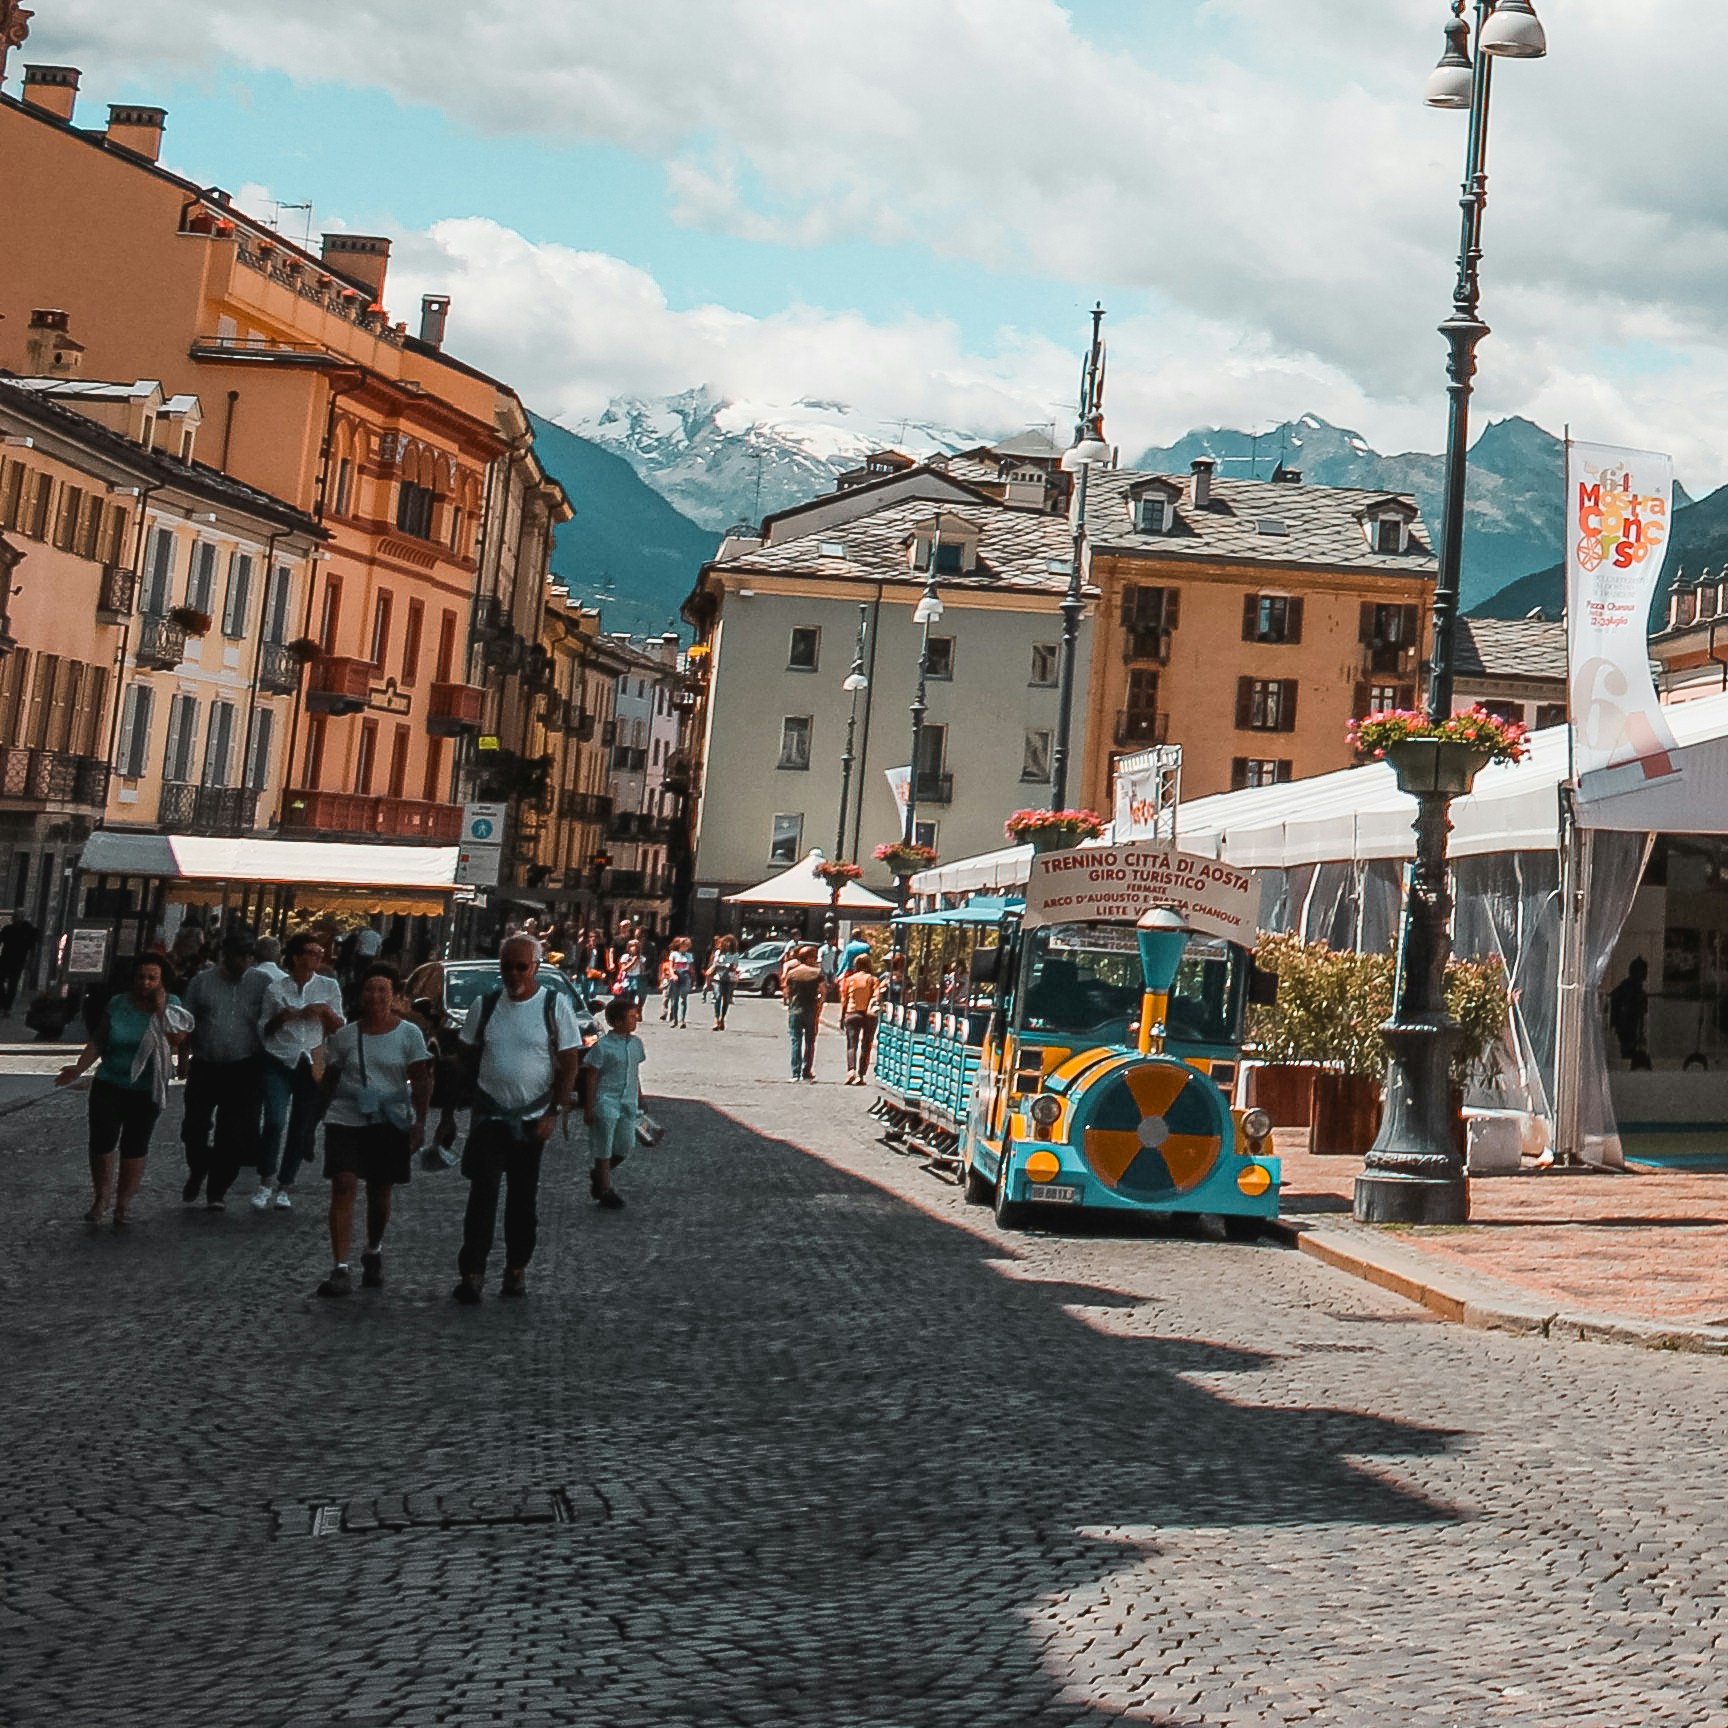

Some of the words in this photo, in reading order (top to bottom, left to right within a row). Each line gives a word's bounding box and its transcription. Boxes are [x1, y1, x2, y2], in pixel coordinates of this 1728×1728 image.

[1040, 851, 1117, 874] TRENINO
[1124, 851, 1171, 870] CITTÀ
[1177, 858, 1194, 875] DI
[1200, 865, 1250, 893] AOSTA
[1088, 869, 1127, 883] GIRO
[1131, 869, 1206, 892] TURISTICO
[1126, 883, 1167, 896] FERMATE
[1043, 896, 1073, 909] ARCO
[1076, 892, 1140, 905] D'AUGUSTO
[1192, 902, 1242, 927] CHANOUX
[1096, 905, 1128, 917] LIETE
